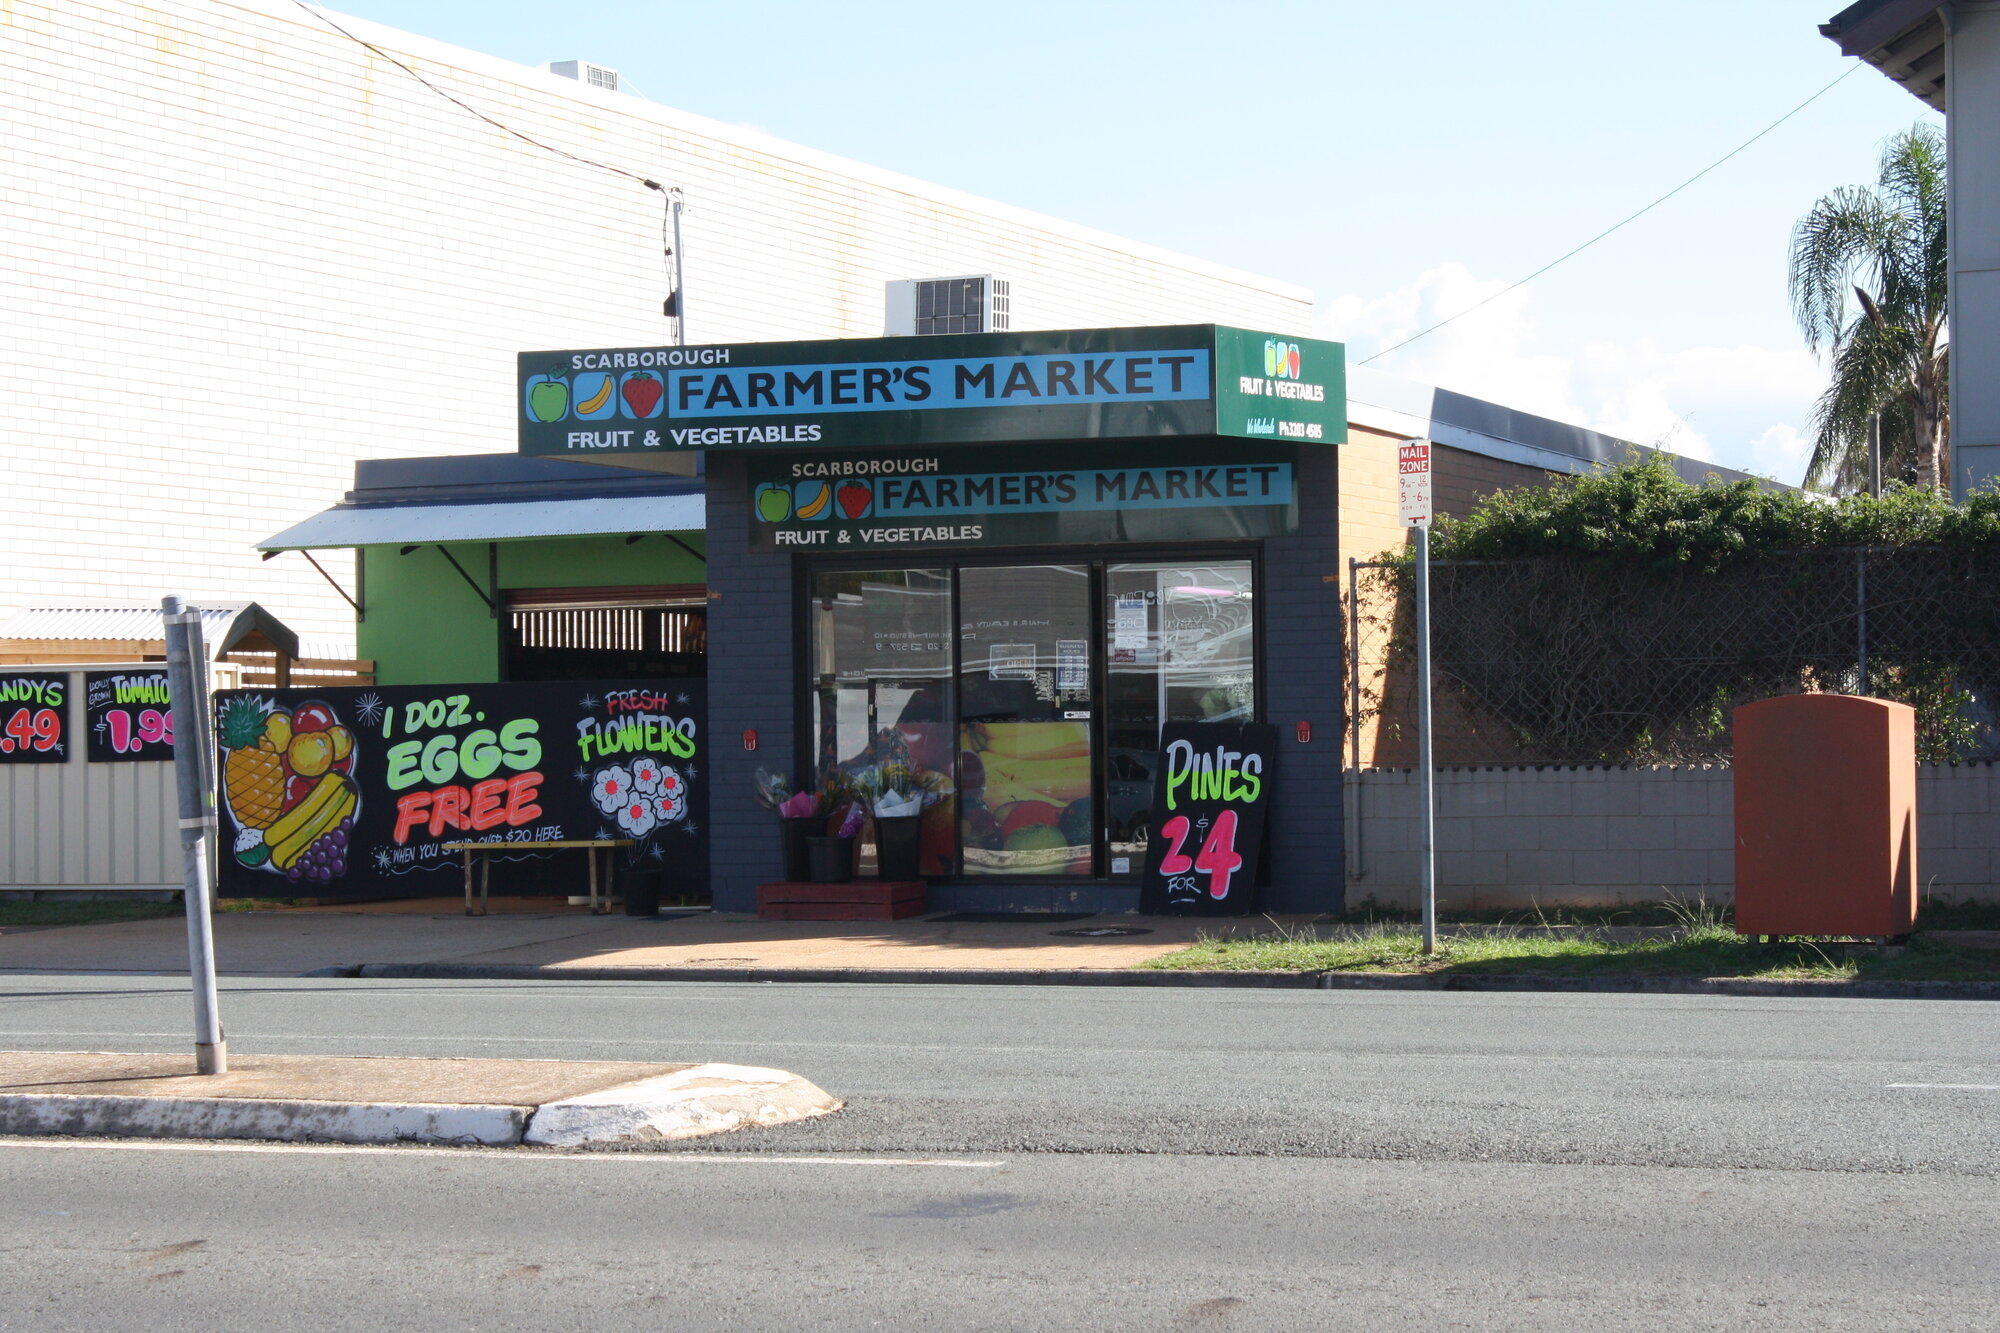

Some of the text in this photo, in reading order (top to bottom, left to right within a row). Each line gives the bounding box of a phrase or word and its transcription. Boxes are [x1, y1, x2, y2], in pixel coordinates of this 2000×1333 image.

[572, 349, 730, 370] SCARBOROUGH
[679, 356, 1195, 410] FARMER'S MARKET
[1240, 376, 1325, 402] FRUIT & VEGETABLES
[567, 424, 822, 449] FRUIT & VEGETABLES
[792, 457, 939, 477] SCARBOROUGH
[1400, 460, 1428, 473] ZONE
[1401, 447, 1427, 459] MAIL
[882, 466, 1279, 509] FARMER'S MARKET
[775, 525, 983, 545] FRUIT & VEGETABLES
[0, 678, 64, 706] NDYS
[605, 689, 669, 715] FRESH
[404, 694, 486, 734] DOZ.
[576, 711, 696, 762] FLOWERS
[386, 718, 542, 790] EGGS
[1166, 739, 1263, 811] PINES
[393, 771, 544, 844] FREE
[393, 847, 416, 864] WHEN
[419, 844, 439, 860] YOU
[505, 828, 531, 843] $20
[535, 825, 564, 842] HERE
[1159, 815, 1192, 877] 2
[1168, 876, 1202, 894] FOR
